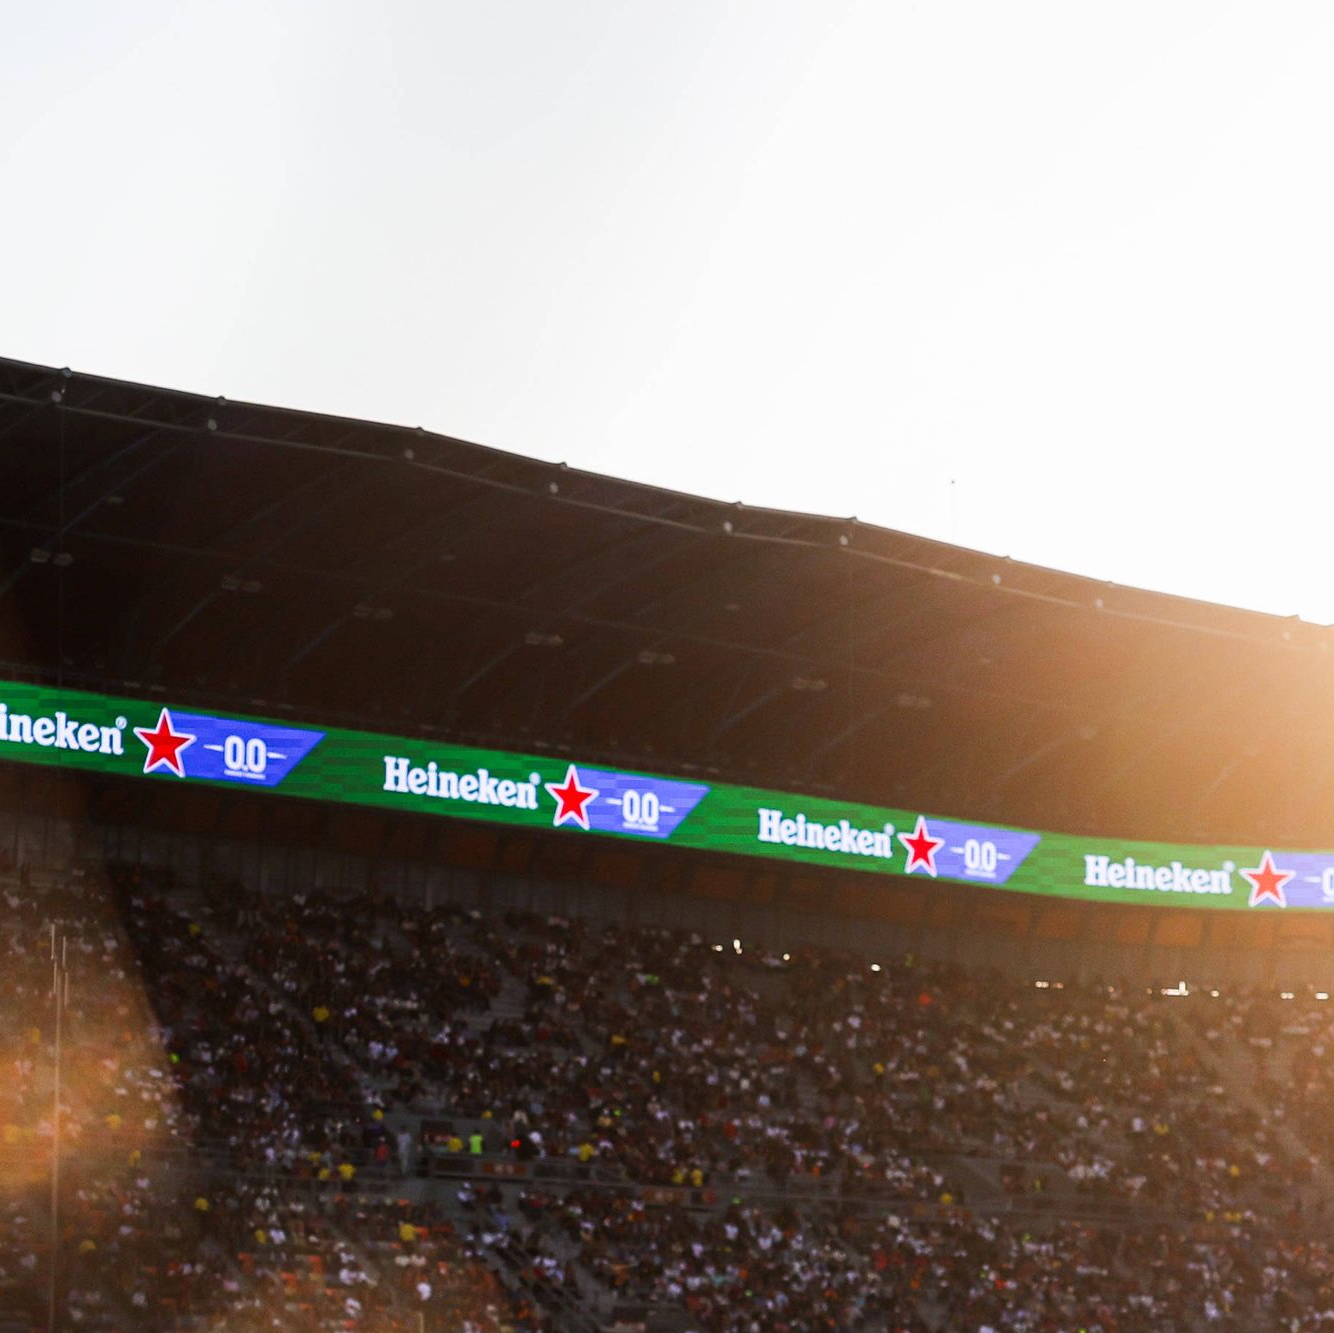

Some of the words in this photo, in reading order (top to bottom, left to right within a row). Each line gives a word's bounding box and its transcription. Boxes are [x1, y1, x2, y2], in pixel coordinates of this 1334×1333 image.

[224, 735, 267, 773] 0.0
[383, 756, 538, 809] Heineken
[622, 789, 660, 826] 0.0
[758, 808, 893, 858] Heineken
[1084, 854, 1233, 895] Heineken
